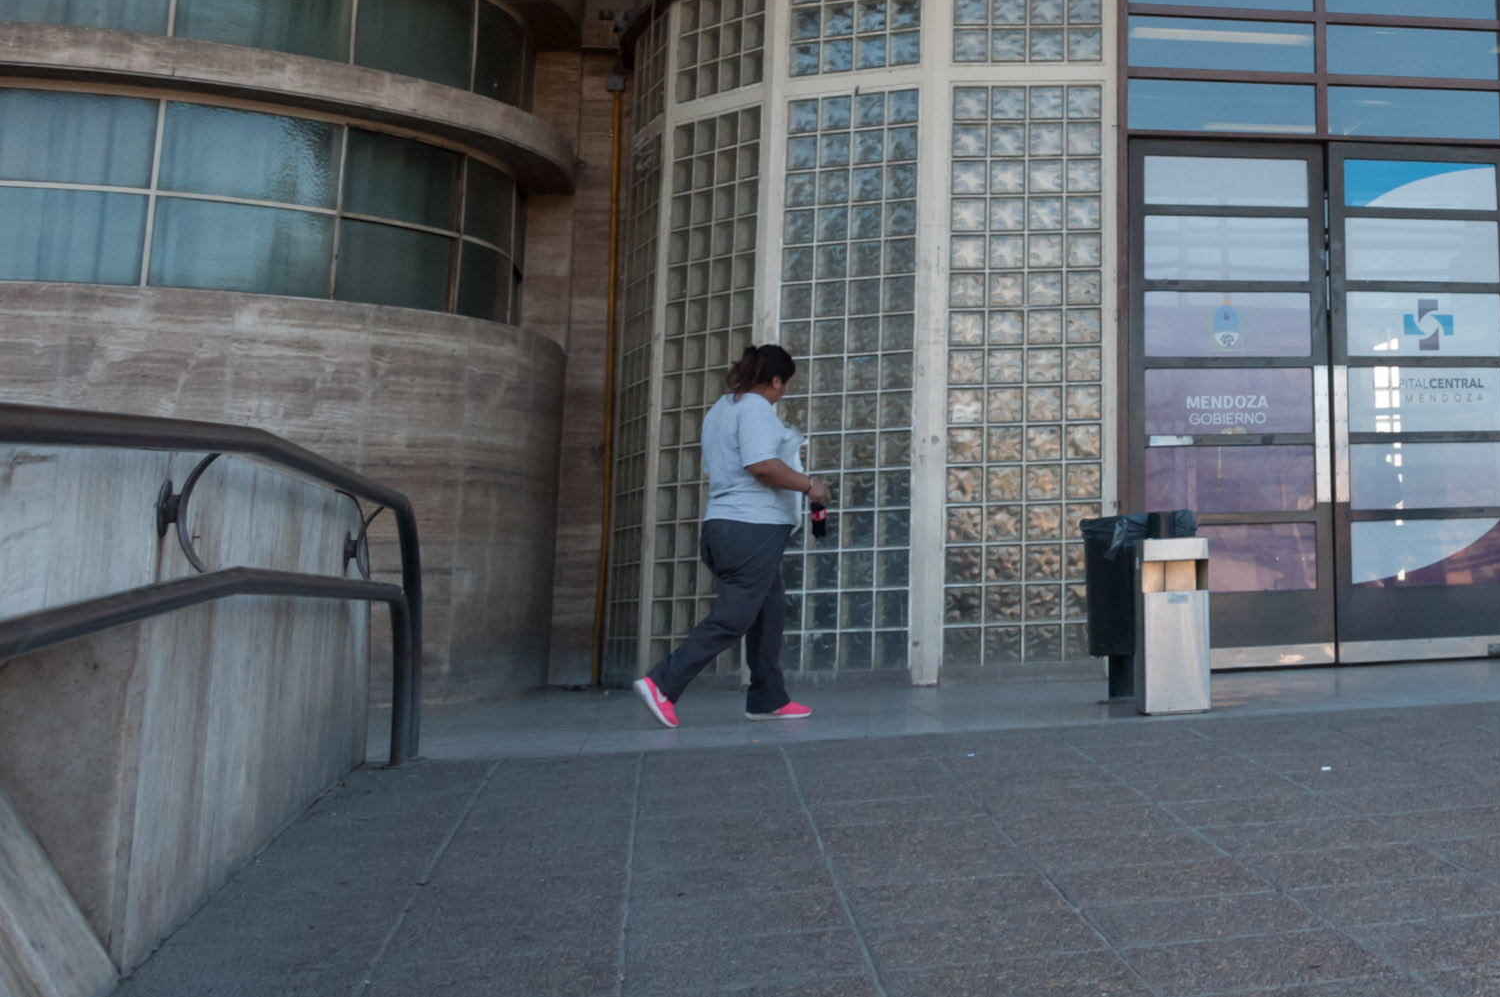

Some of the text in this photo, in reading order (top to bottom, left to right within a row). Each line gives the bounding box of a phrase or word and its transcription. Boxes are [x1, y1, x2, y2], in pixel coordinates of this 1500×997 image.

[1186, 395, 1269, 410] MENDOZA
[1404, 393, 1484, 404] MENDOZA
[1188, 411, 1267, 425] GOBIERNO
